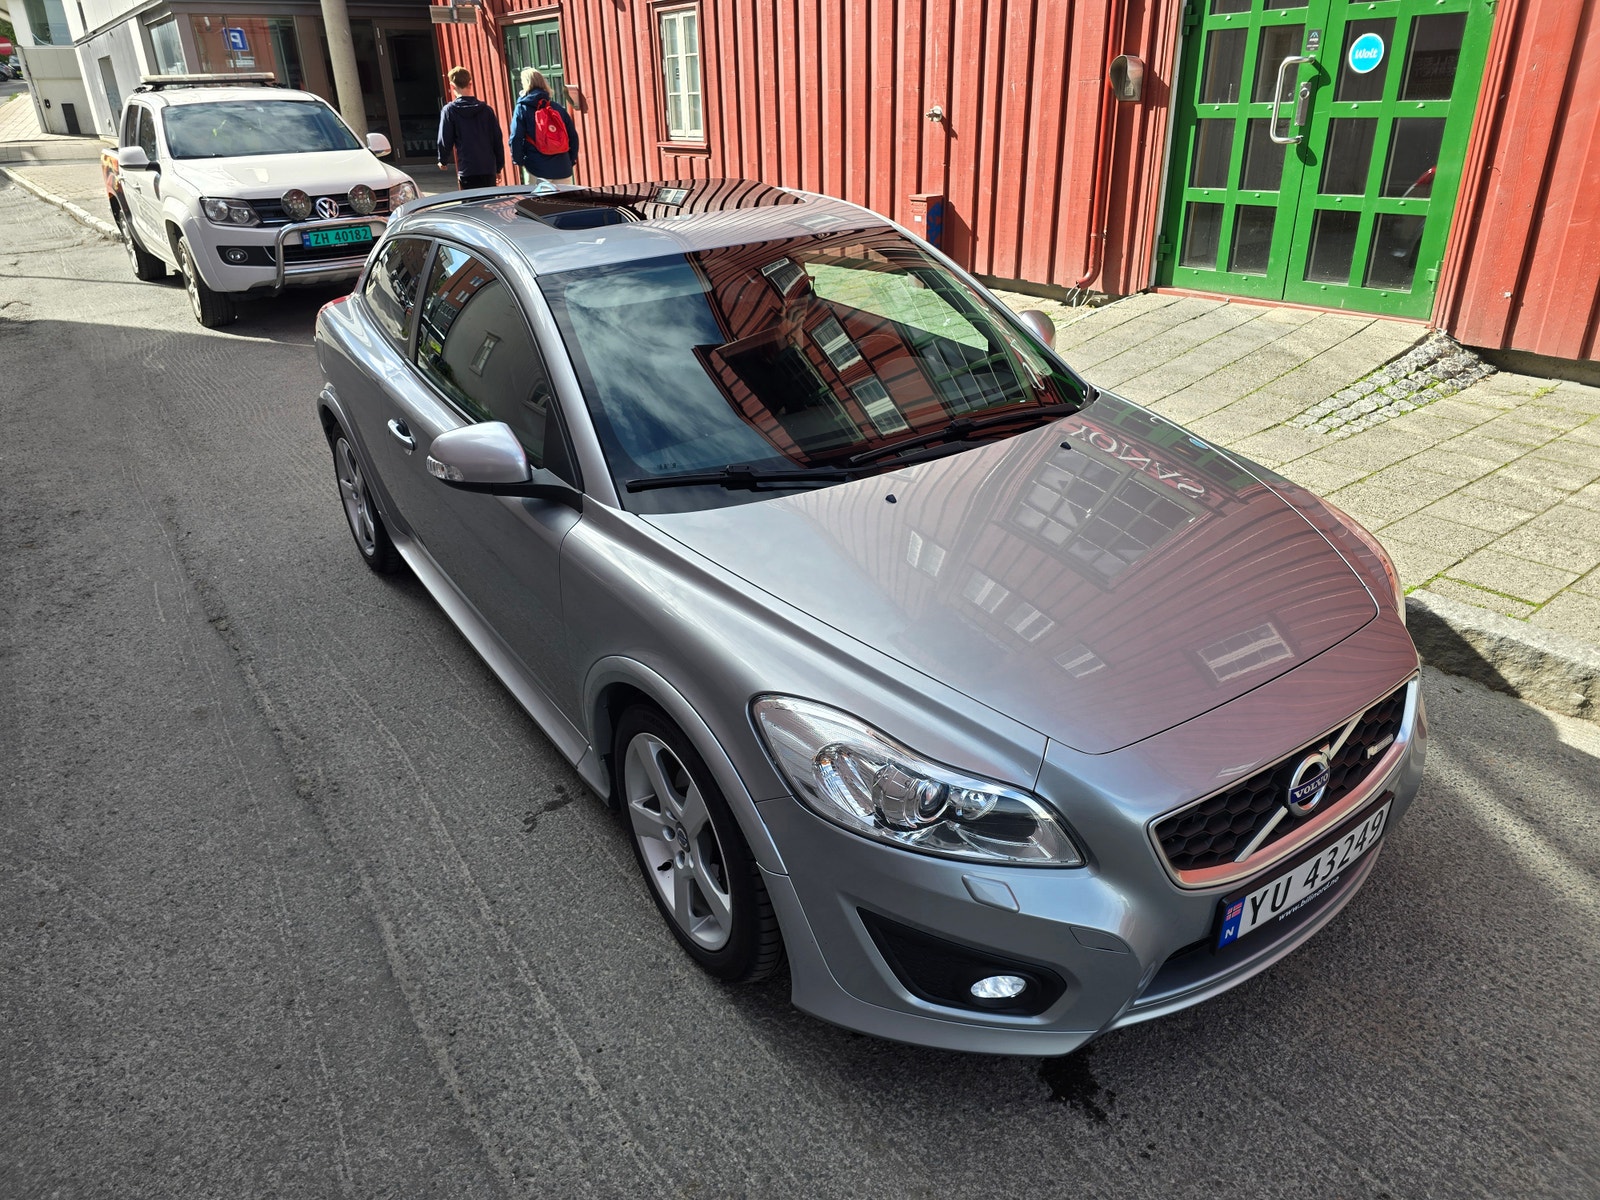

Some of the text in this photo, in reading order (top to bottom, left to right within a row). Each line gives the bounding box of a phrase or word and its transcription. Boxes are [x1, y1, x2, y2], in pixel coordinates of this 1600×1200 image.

[1355, 47, 1379, 60] Wolt
[313, 232, 330, 245] ZH
[335, 228, 369, 243] 40182
[1293, 772, 1329, 799] VOLVO
[1250, 809, 1385, 926] YU 43249
[1225, 926, 1235, 940] N
